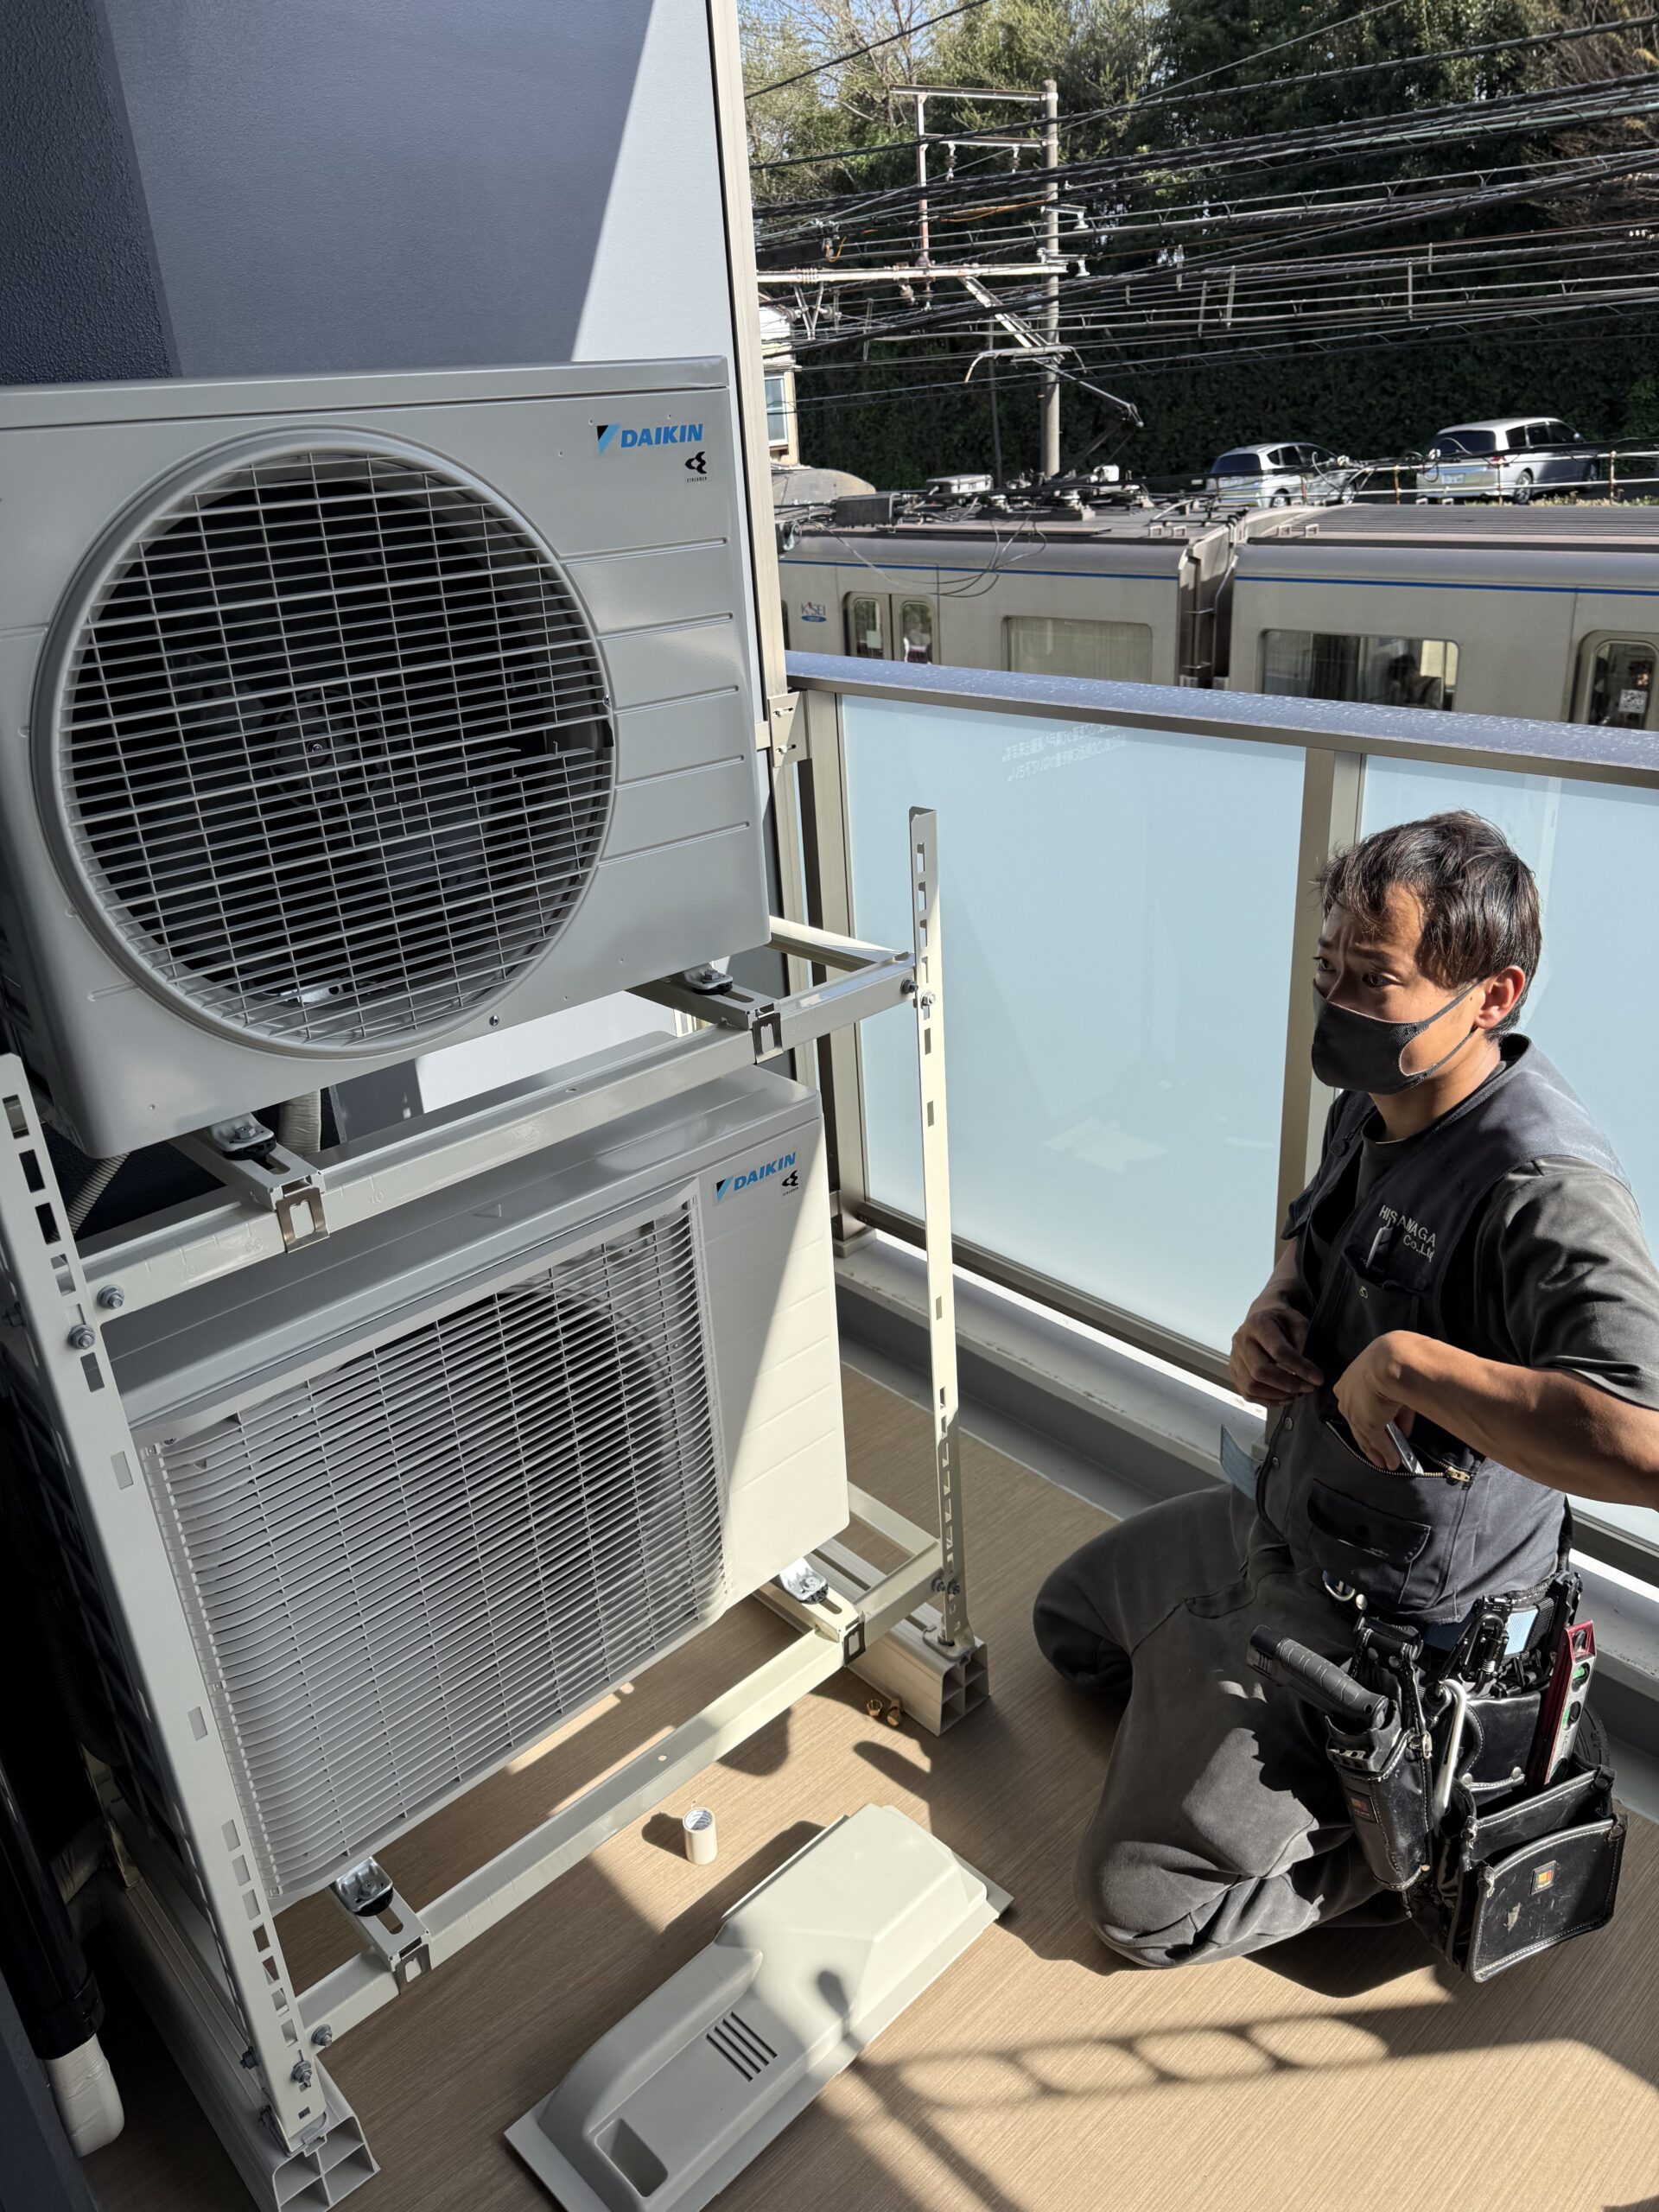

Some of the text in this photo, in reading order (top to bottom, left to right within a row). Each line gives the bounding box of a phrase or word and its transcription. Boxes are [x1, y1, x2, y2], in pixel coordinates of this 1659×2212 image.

[620, 423, 703, 448] DAIKIN
[734, 1152, 796, 1191] DAIKIN
[1379, 1205, 1435, 1247] HISANAGA
